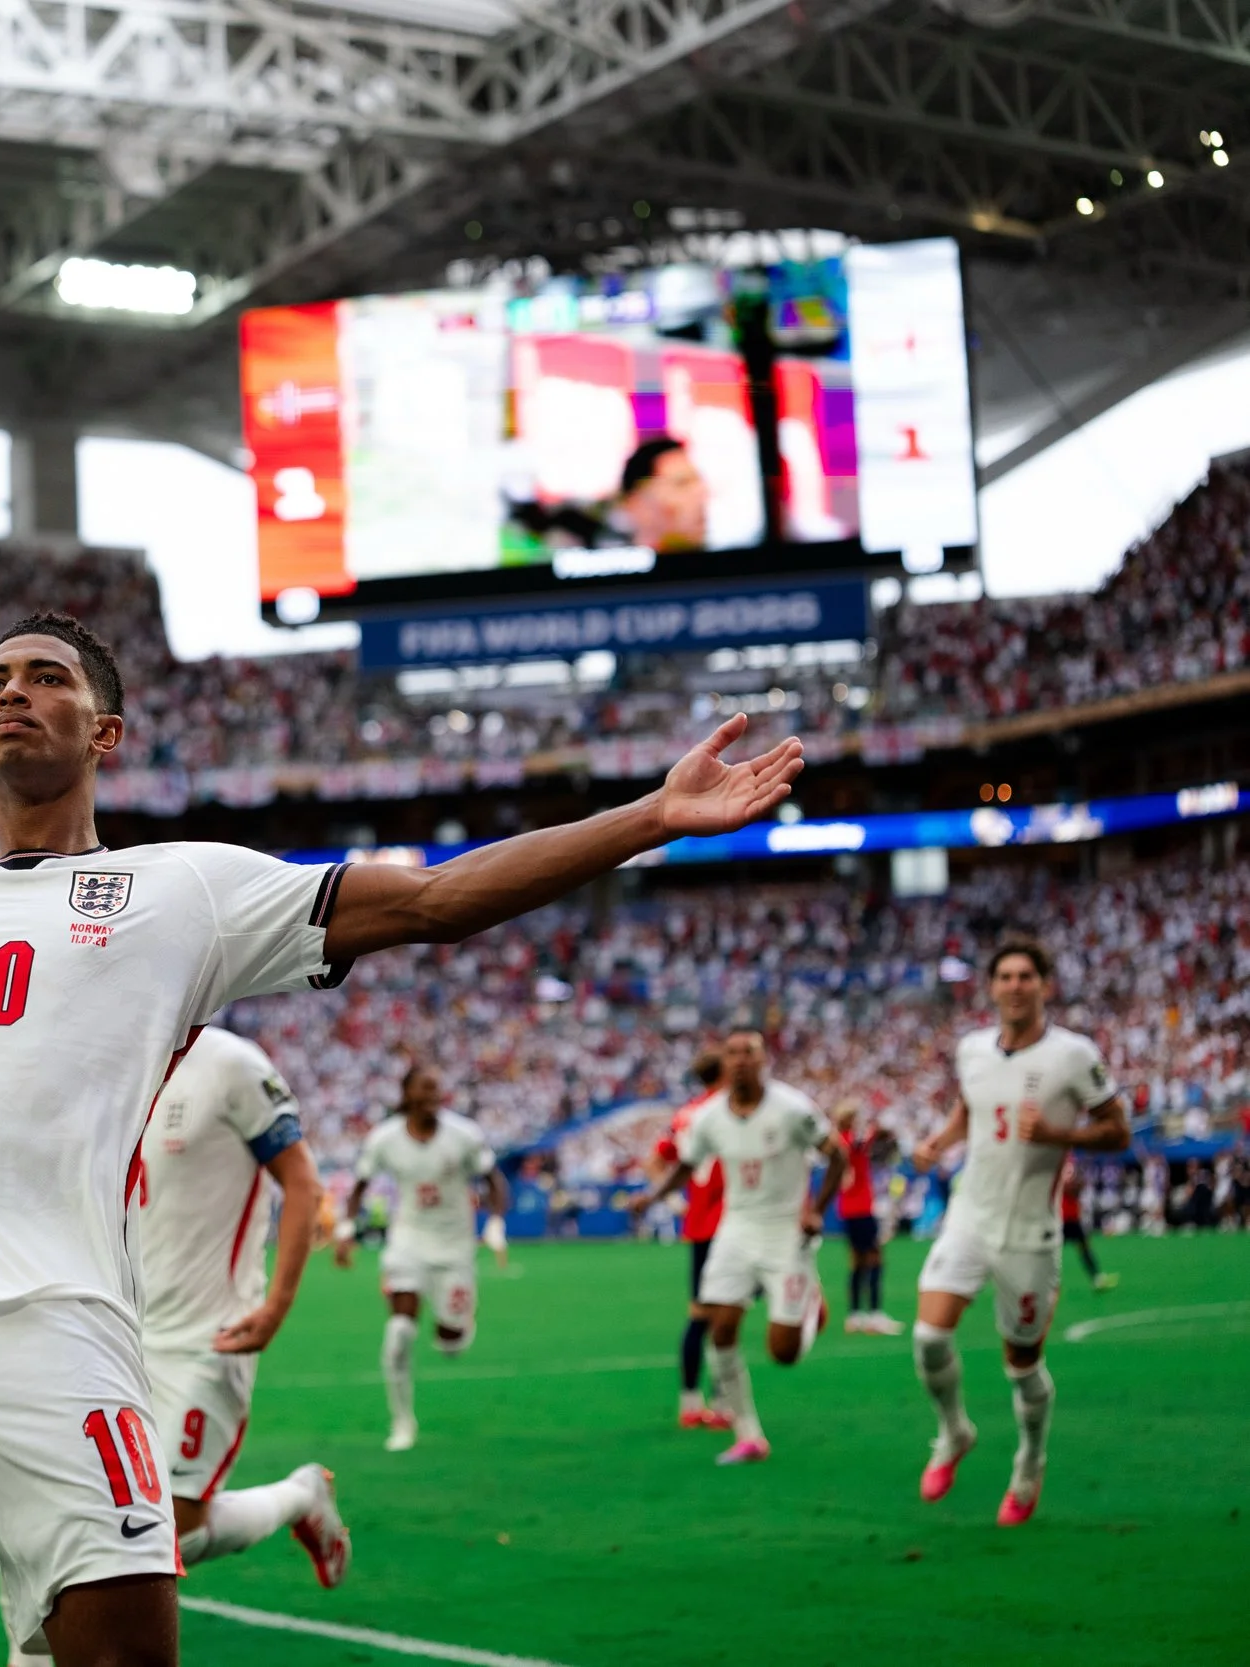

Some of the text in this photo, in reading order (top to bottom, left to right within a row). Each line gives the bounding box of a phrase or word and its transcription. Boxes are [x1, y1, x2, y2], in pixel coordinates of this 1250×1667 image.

[895, 424, 930, 461] 1
[398, 592, 821, 659] FIFA WORLD CUP 2026
[70, 923, 114, 935] NORWAY
[71, 934, 107, 947] 11.07.26
[994, 1104, 1010, 1142] 5
[1018, 1291, 1037, 1326] 5
[180, 1408, 206, 1460] 9
[83, 1407, 162, 1508] 10
